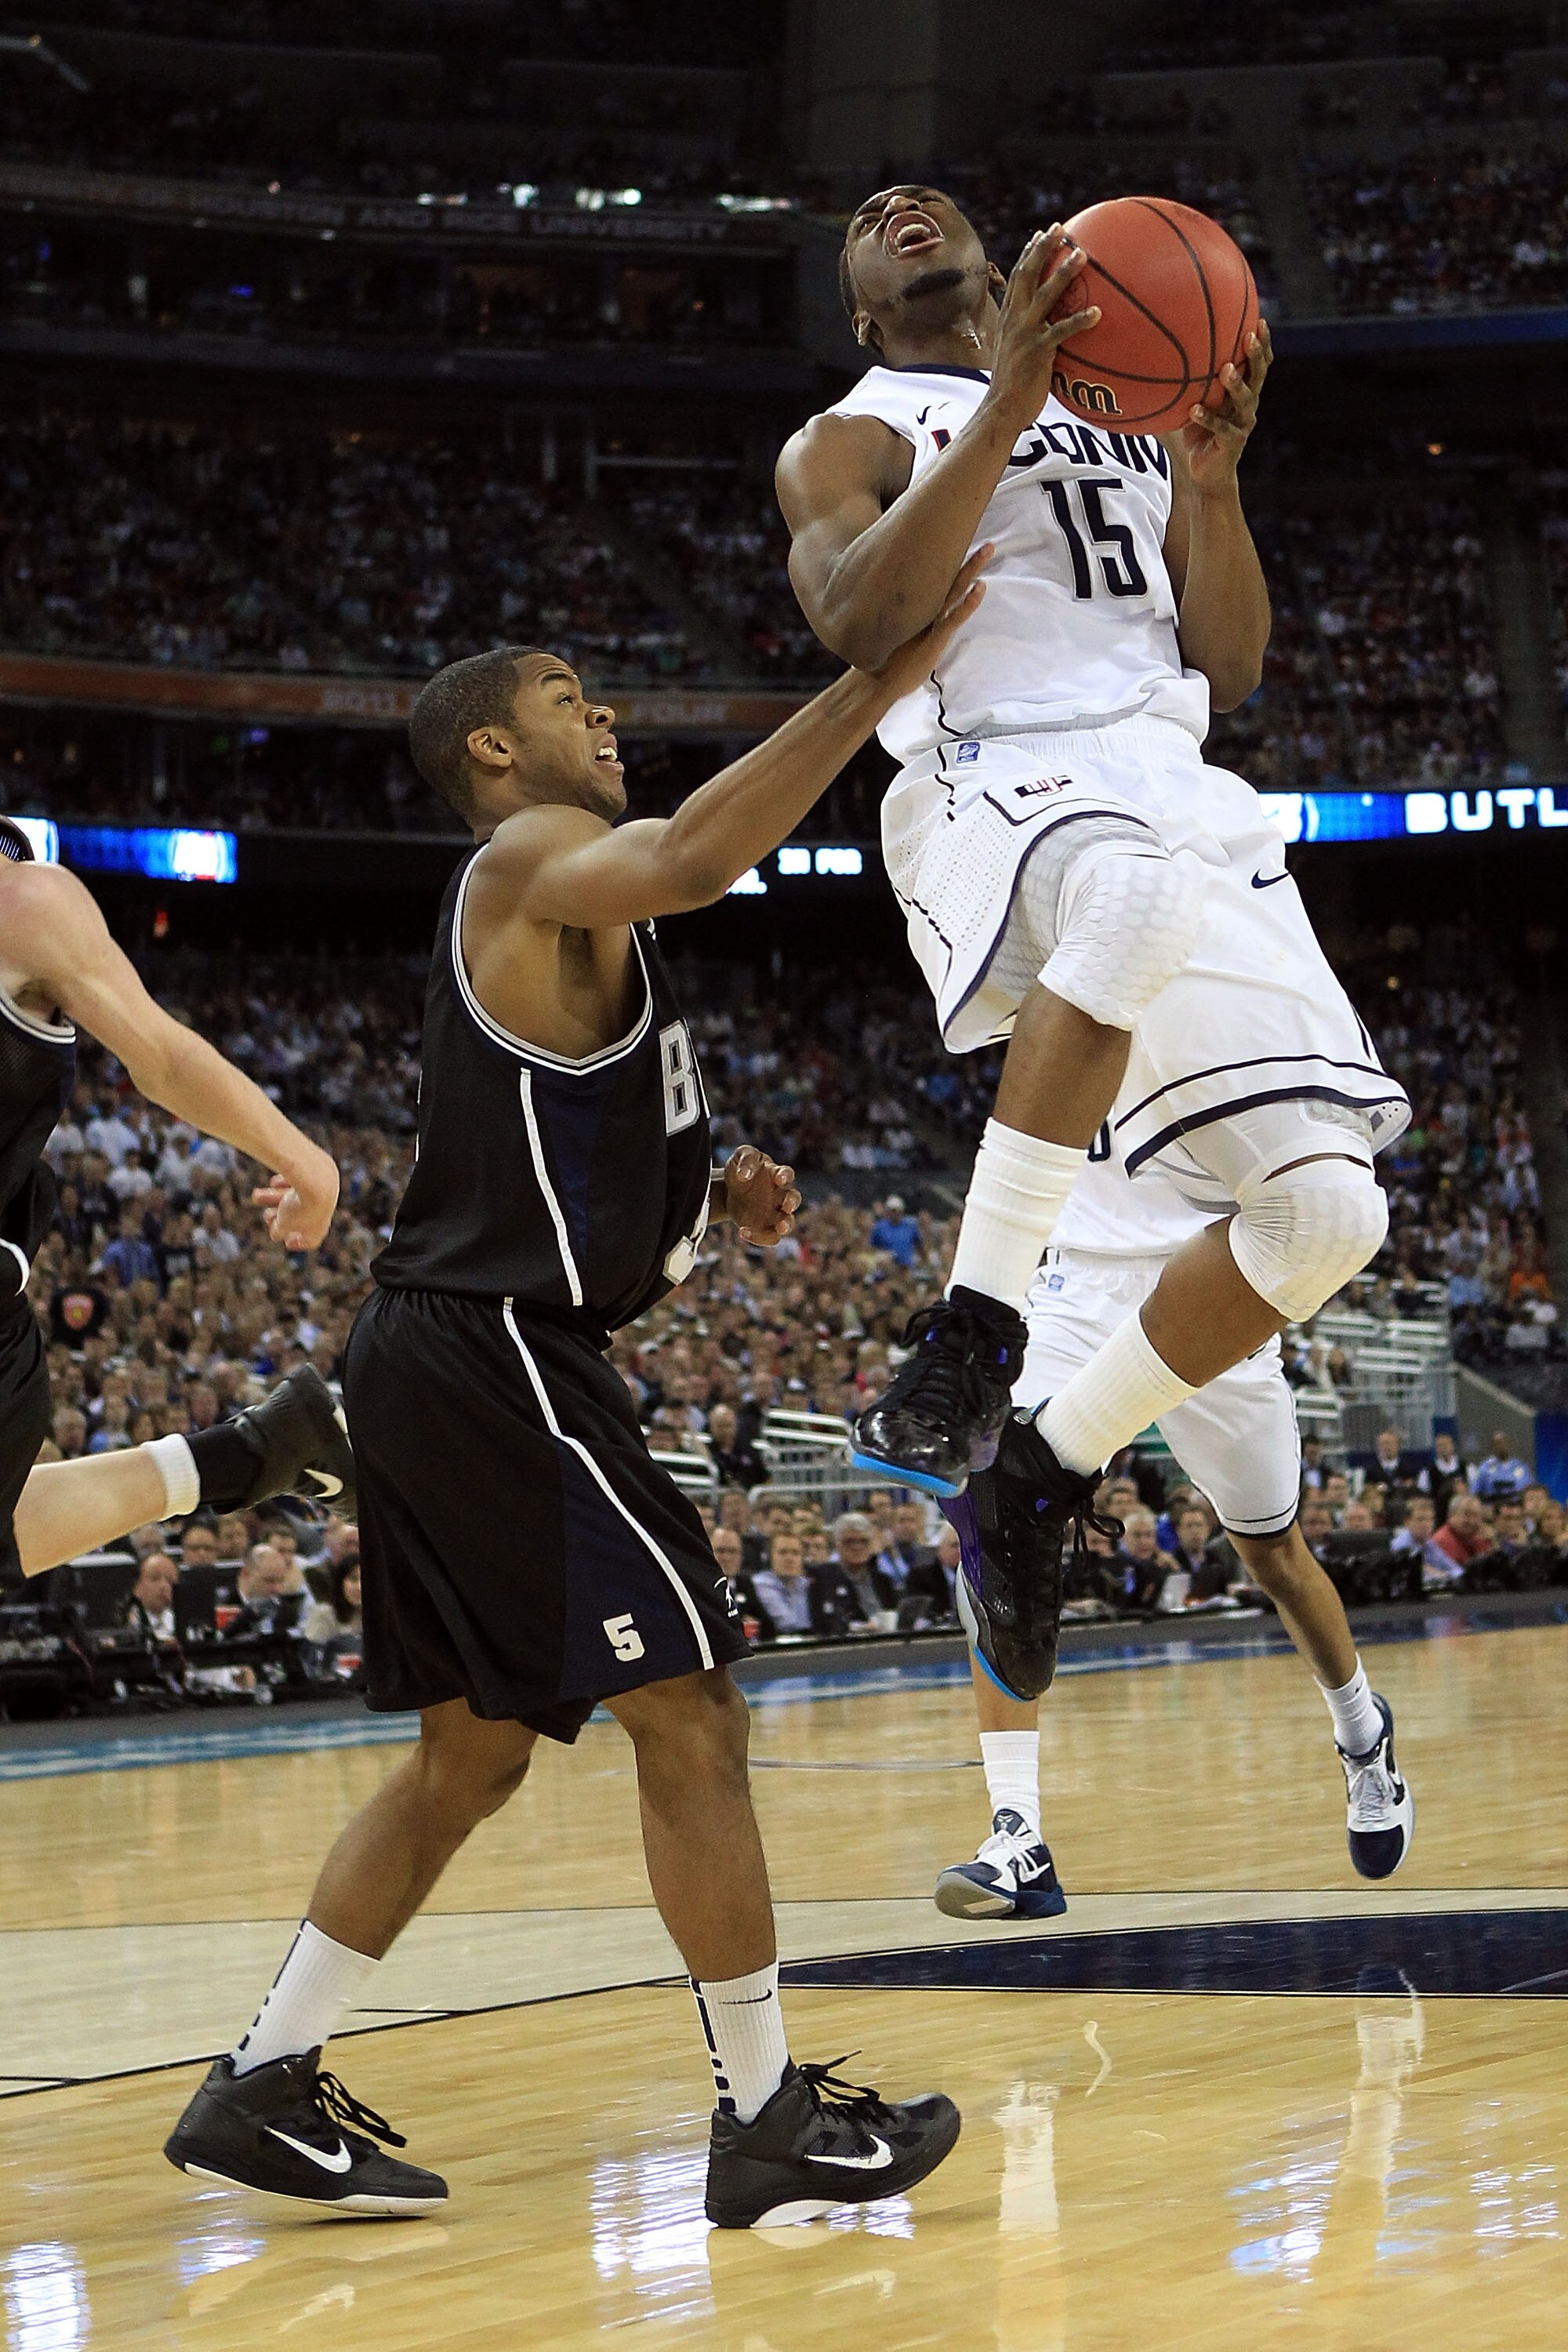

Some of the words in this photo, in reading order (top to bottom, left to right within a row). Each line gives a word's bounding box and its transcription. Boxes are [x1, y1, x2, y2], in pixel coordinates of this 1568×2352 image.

[1040, 478, 1148, 602] 15
[1405, 787, 1568, 834] BUTL
[659, 1018, 710, 1137] B
[603, 1613, 645, 1662] 5
